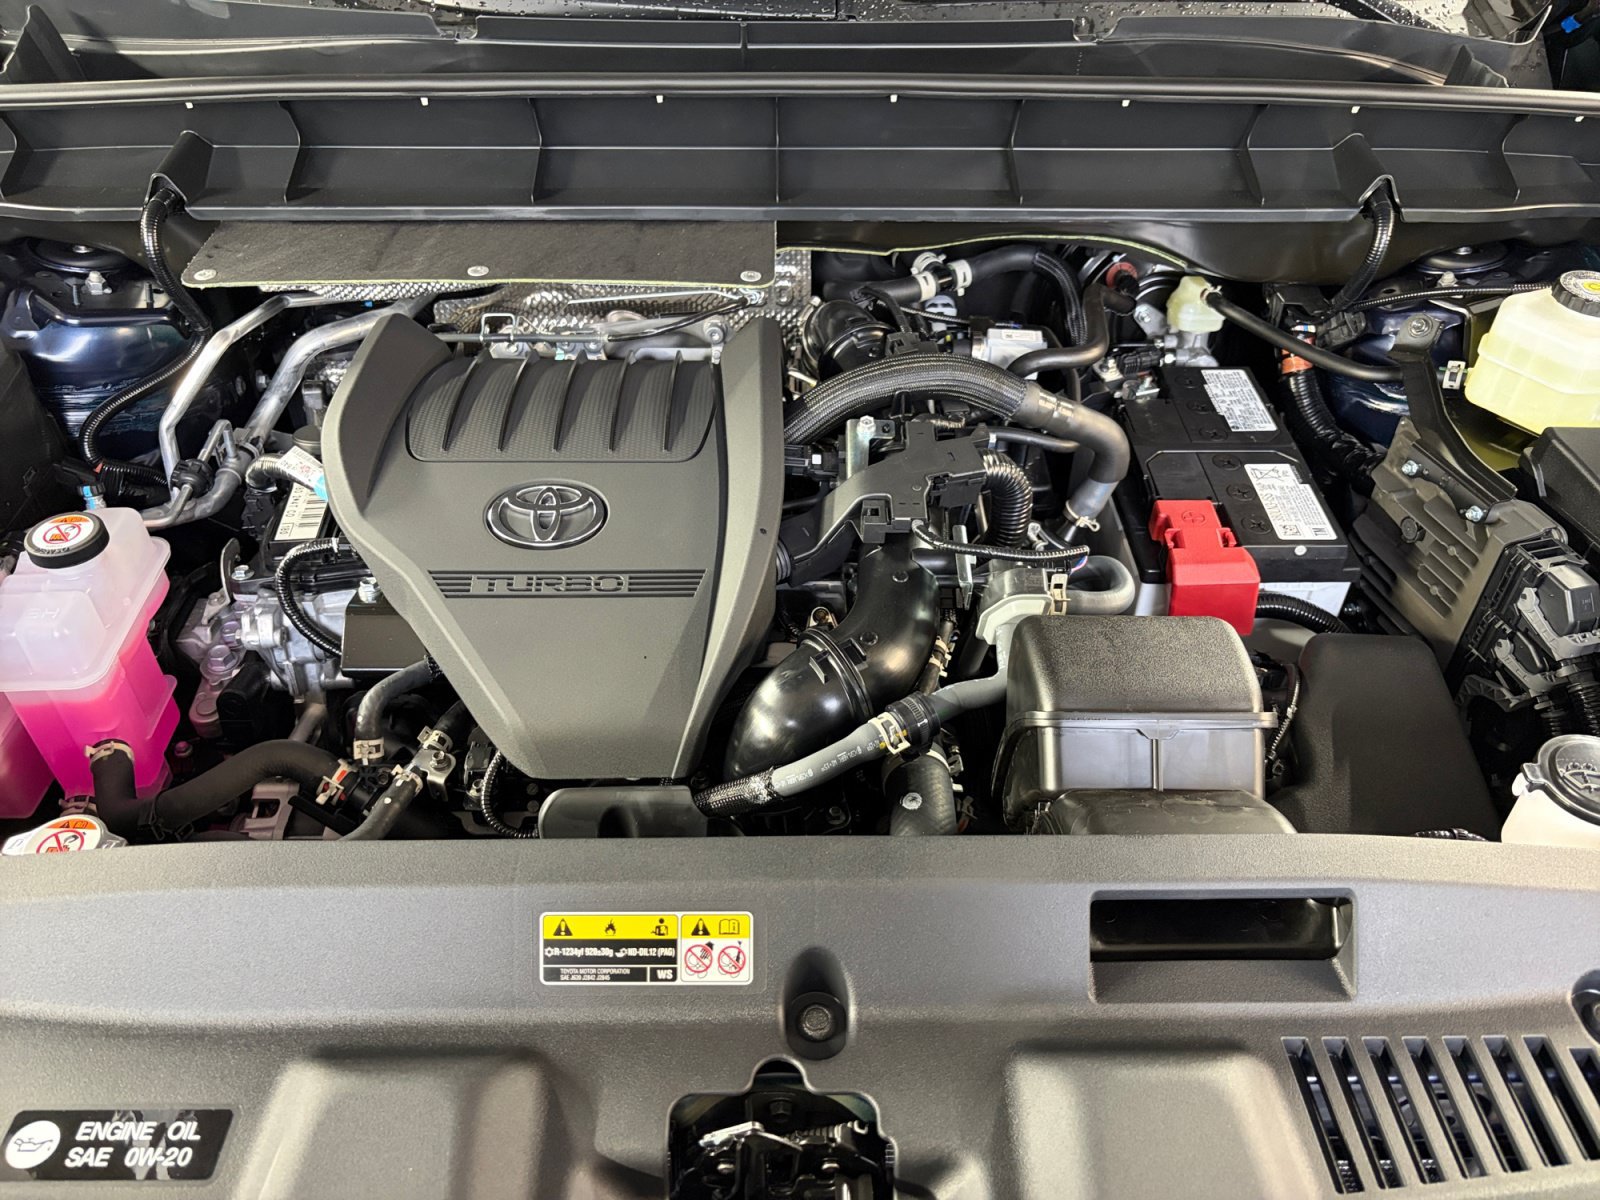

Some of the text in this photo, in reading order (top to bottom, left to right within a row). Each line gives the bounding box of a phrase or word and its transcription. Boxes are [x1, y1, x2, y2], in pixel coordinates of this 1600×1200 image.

[476, 575, 626, 592] TURBO
[658, 947, 675, 958] (PAG)
[656, 969, 673, 980] WS
[75, 1121, 201, 1141] ENGINE OIL
[64, 1147, 193, 1168] SAE 0W-20
